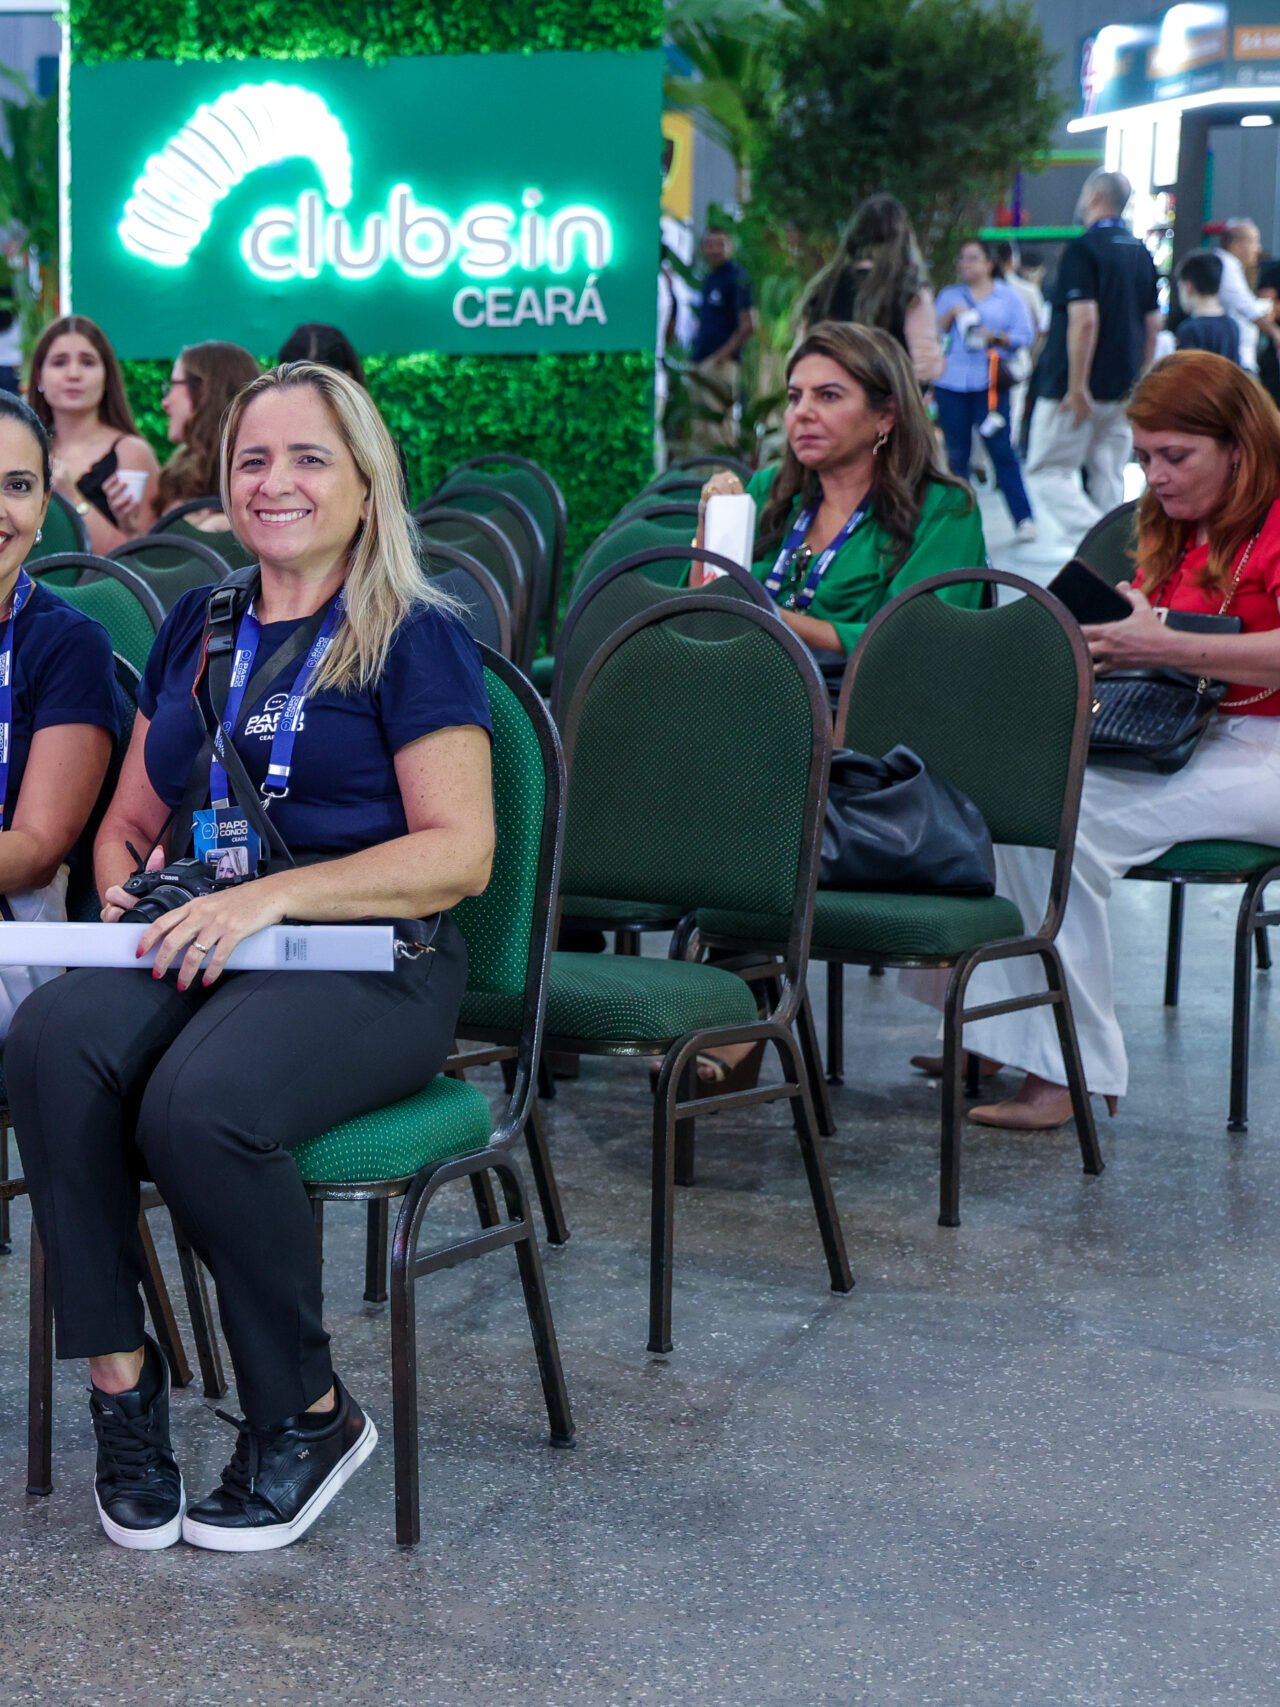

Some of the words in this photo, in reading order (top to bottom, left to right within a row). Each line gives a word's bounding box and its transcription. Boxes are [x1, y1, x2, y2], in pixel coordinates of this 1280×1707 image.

[242, 184, 612, 279] clubsin
[453, 274, 606, 328] CEARÁ
[219, 820, 248, 830] PAPO
[219, 828, 249, 837] CONDO
[160, 873, 179, 881] Canon
